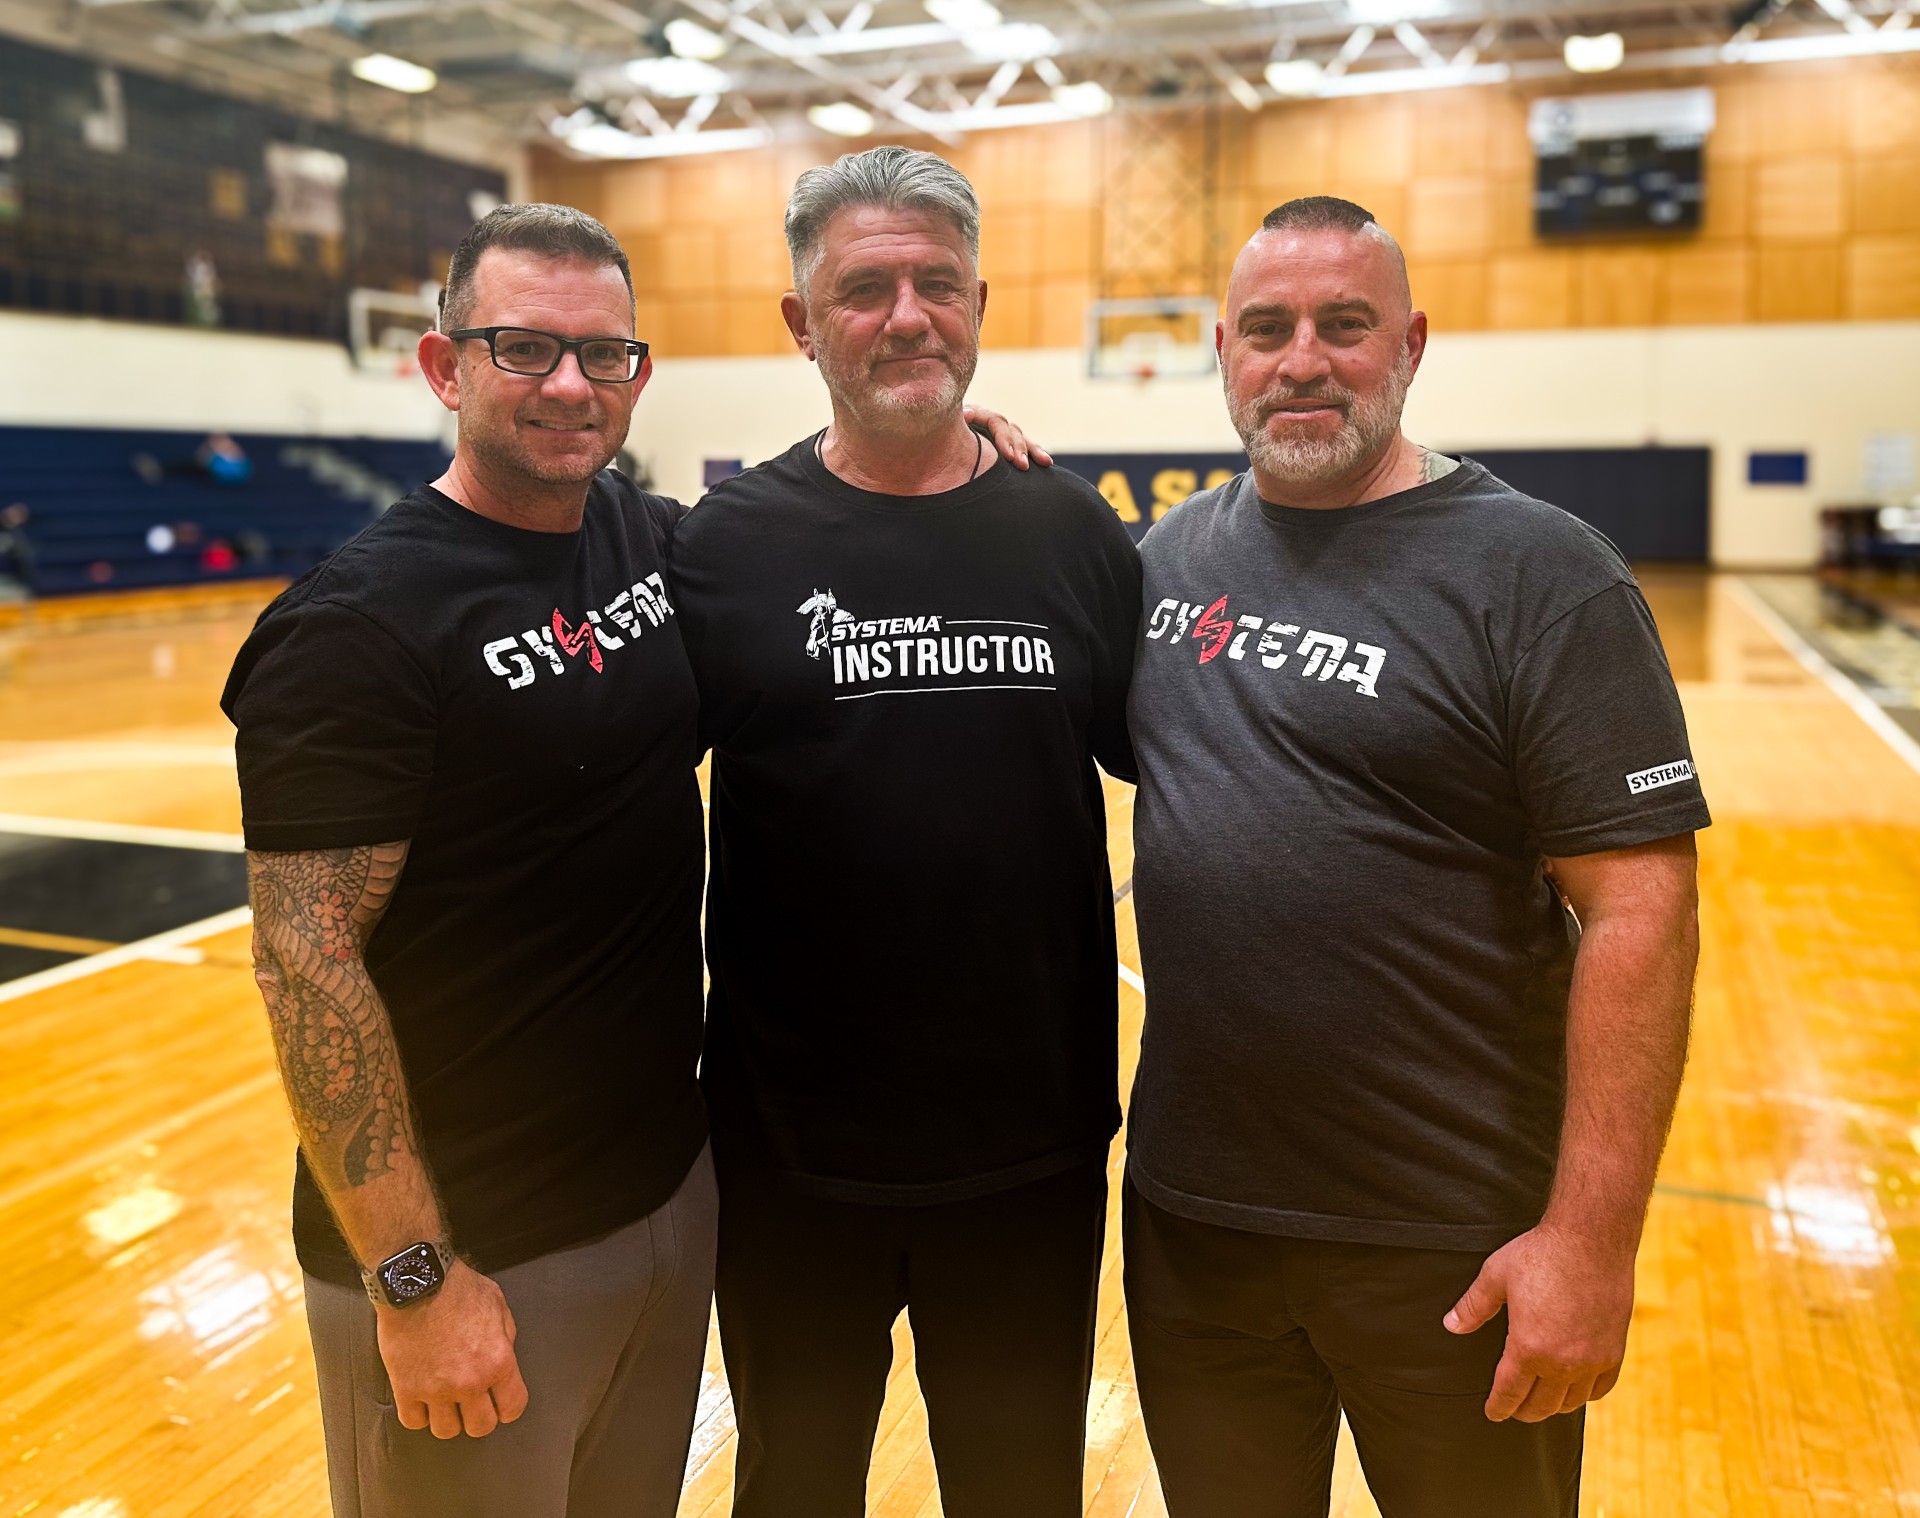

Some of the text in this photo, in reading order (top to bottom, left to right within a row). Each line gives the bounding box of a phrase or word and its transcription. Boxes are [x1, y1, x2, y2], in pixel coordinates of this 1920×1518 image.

[832, 635, 1055, 684] INSTRUCTOR
[1146, 594, 1387, 698] SYSTEMA
[1630, 763, 1691, 789] SYSTEMA
